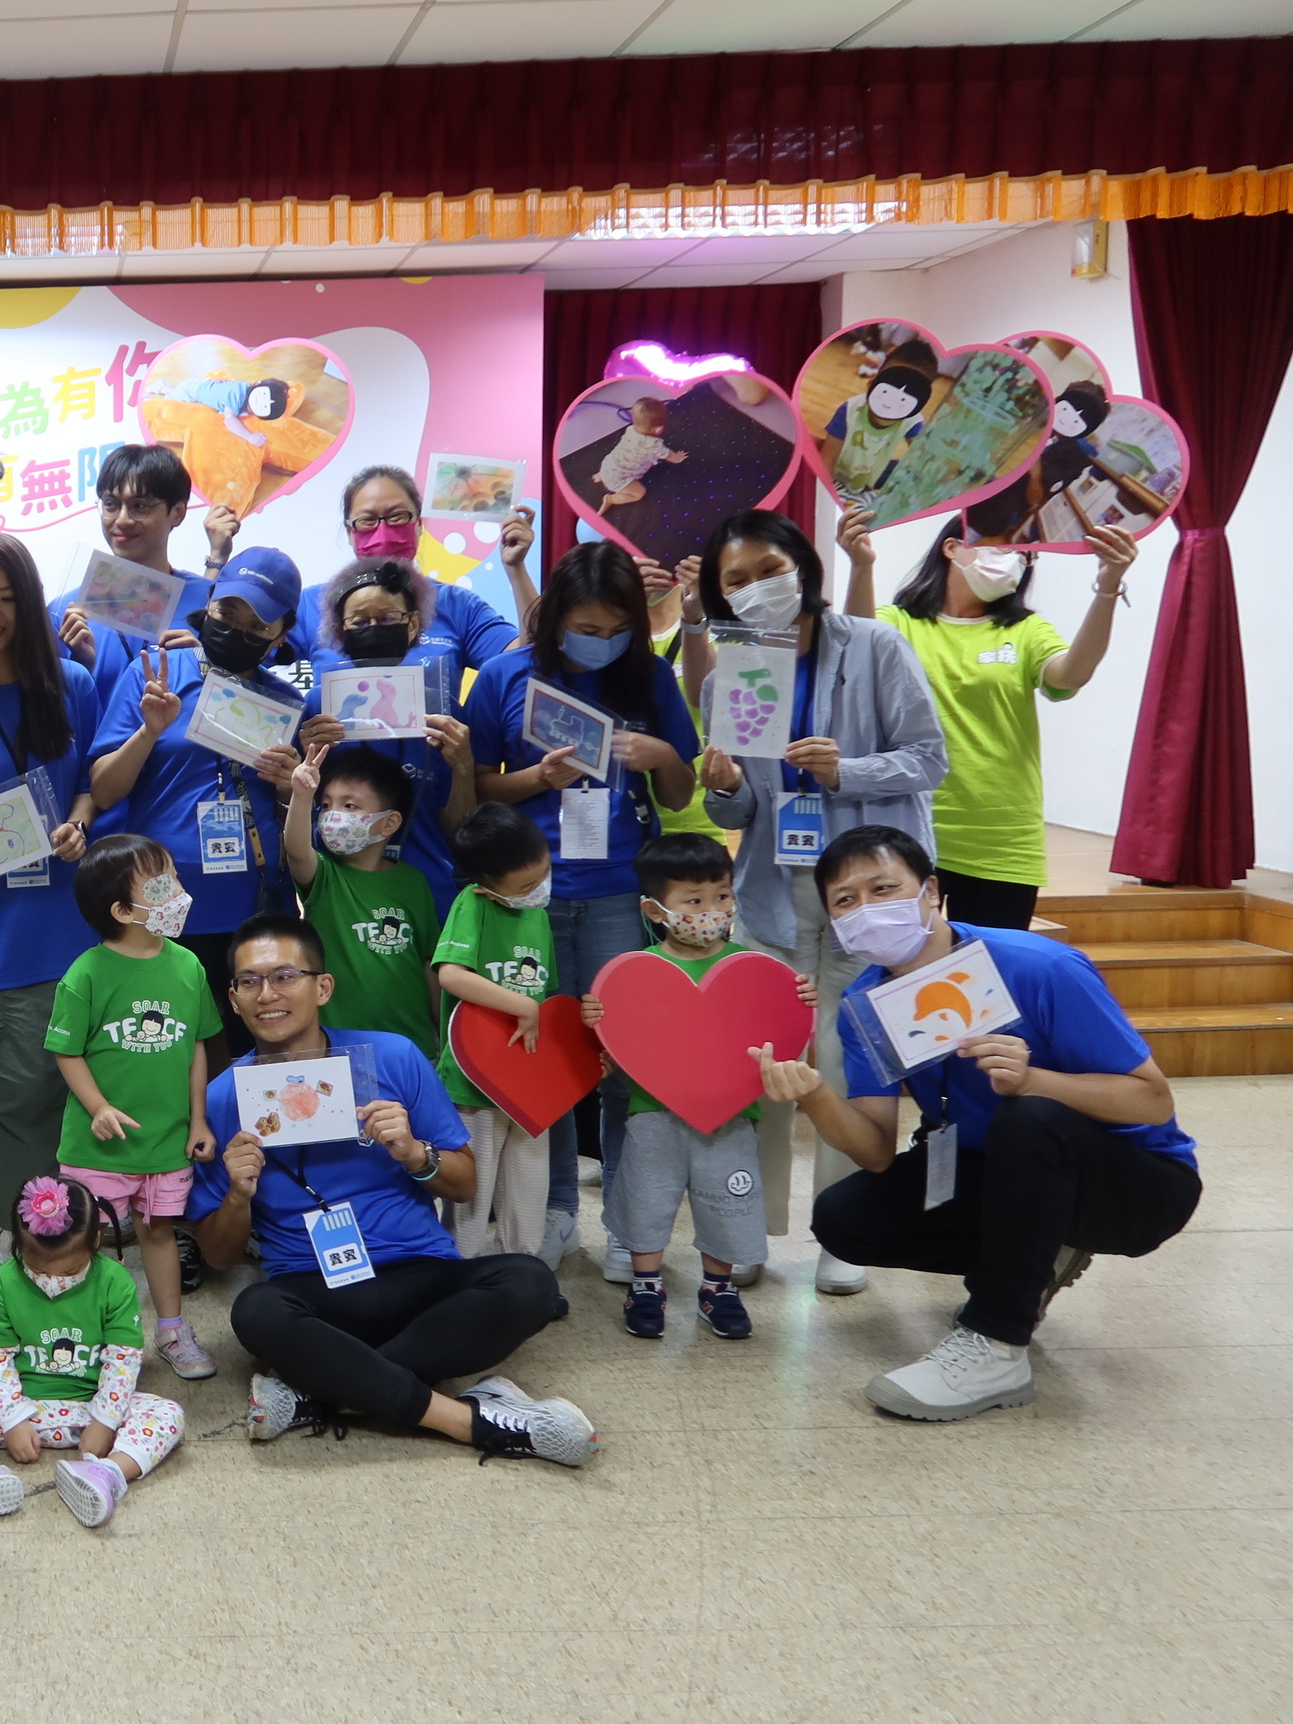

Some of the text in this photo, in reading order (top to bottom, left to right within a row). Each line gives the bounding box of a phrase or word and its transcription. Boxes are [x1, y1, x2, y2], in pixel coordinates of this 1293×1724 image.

[132, 1000, 170, 1015] SOAR
[121, 1038, 151, 1053] WITH
[40, 1327, 83, 1345] SOAR
